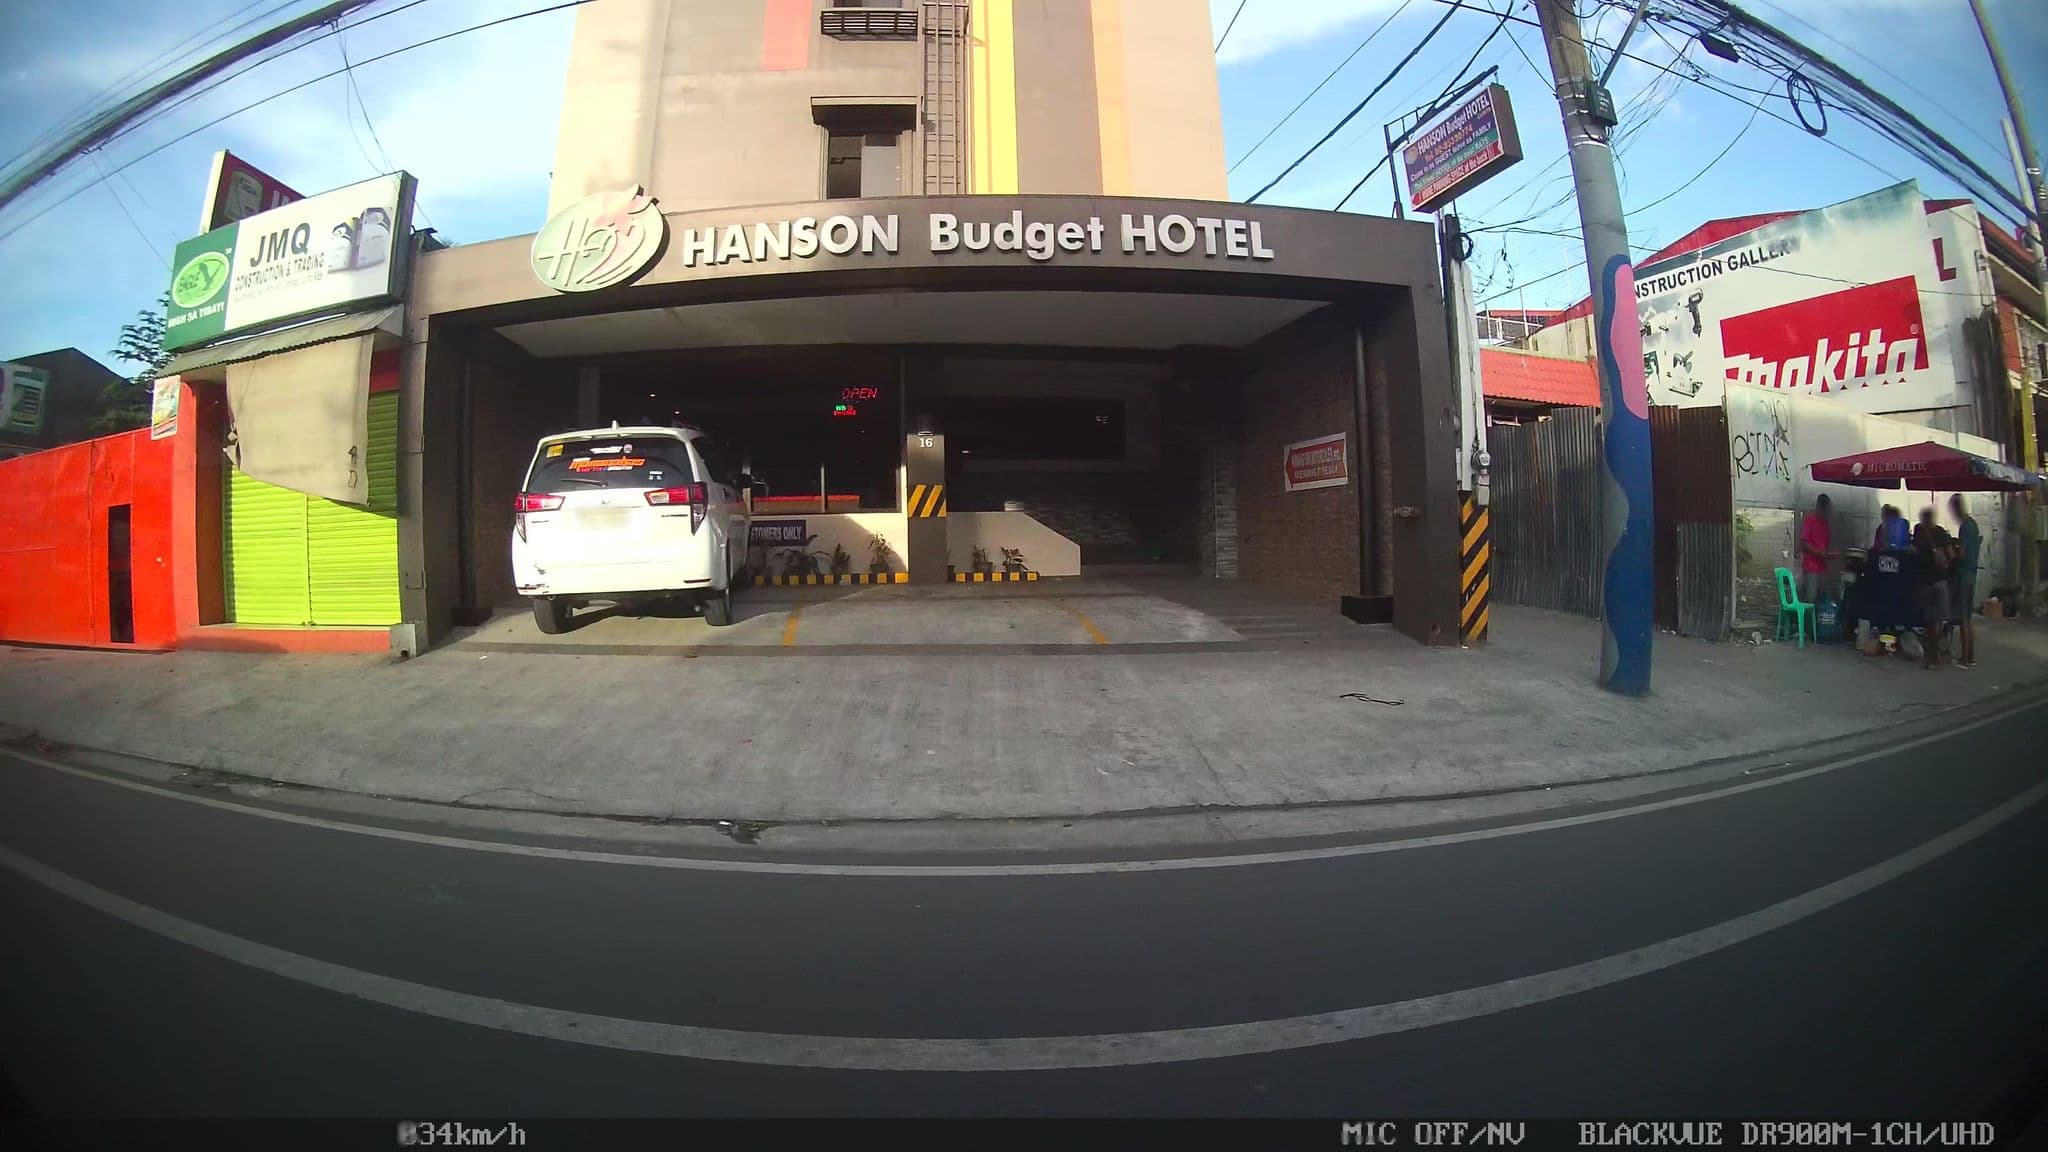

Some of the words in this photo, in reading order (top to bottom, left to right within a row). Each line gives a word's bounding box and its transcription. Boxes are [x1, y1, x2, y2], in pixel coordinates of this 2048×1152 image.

[1418, 124, 1446, 155] HANSON
[1446, 111, 1467, 136] Budget
[1466, 94, 1490, 120] HOTEL
[1472, 121, 1492, 140] FAMILY
[250, 222, 311, 268] JMQ
[683, 214, 899, 266] HANSON
[930, 210, 1104, 260] Budget
[1121, 214, 1274, 260] HOTEL
[235, 264, 284, 291] CONSTRUCTION
[294, 252, 325, 273] TRADING
[1932, 237, 1957, 282] L
[1723, 328, 1919, 393] makita
[841, 387, 878, 399] OPEN
[919, 438, 933, 448] 16
[1867, 461, 1928, 473] MICROMATIC
[783, 526, 802, 540] ONLY
